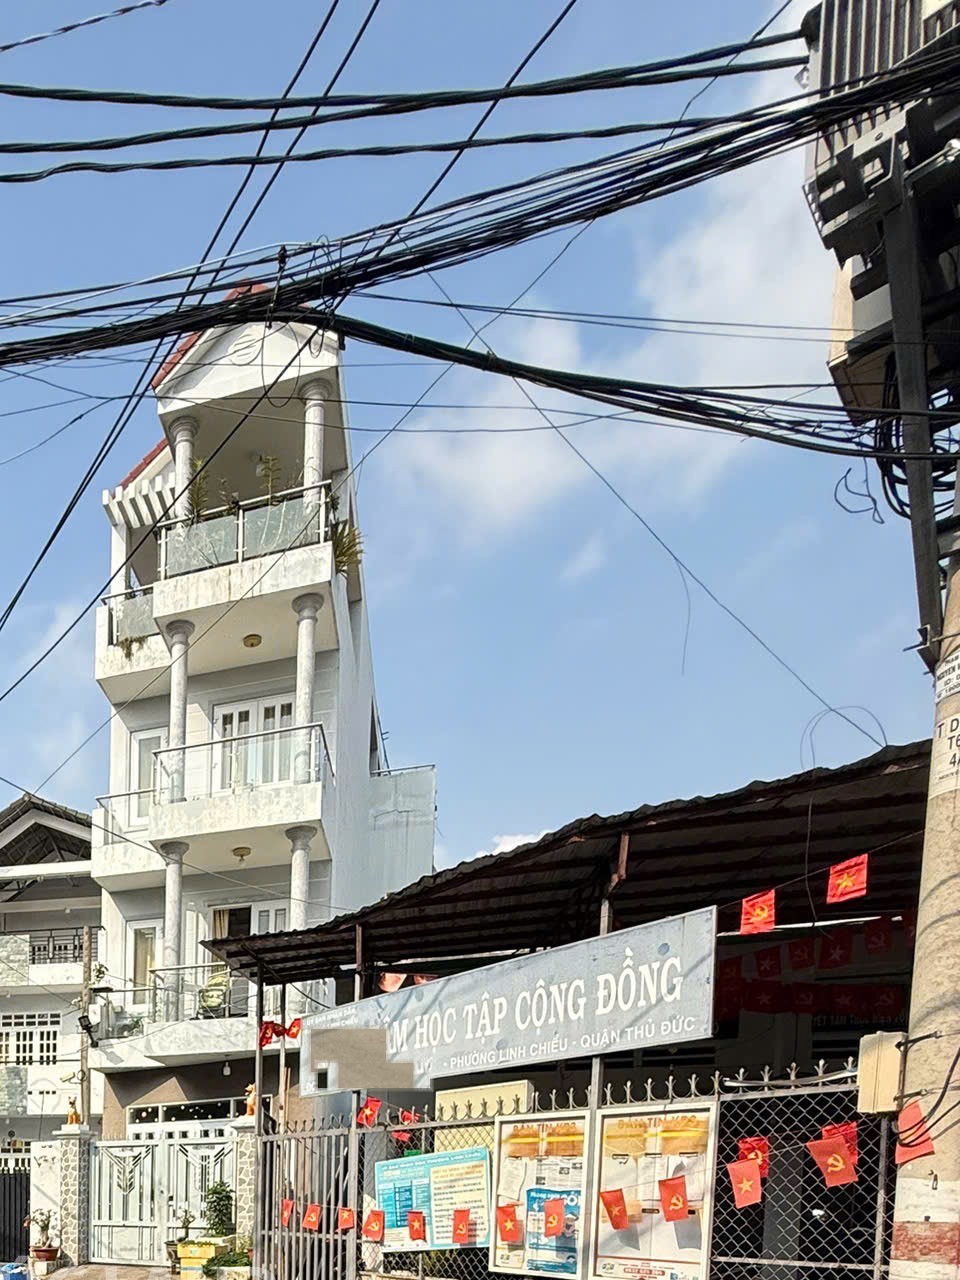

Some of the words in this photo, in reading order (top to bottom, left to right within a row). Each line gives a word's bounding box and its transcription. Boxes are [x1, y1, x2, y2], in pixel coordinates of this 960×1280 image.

[414, 1007, 457, 1053] HỌC
[463, 991, 508, 1044] TẬP
[515, 978, 587, 1035] CỘNG
[595, 946, 684, 1016] ĐỒNG
[450, 1050, 496, 1069] PHƯỜNG
[499, 1045, 526, 1061] LINH
[581, 1028, 621, 1050] QUẬN
[625, 1018, 655, 1041] THỦ
[661, 1015, 697, 1035] ĐỨC
